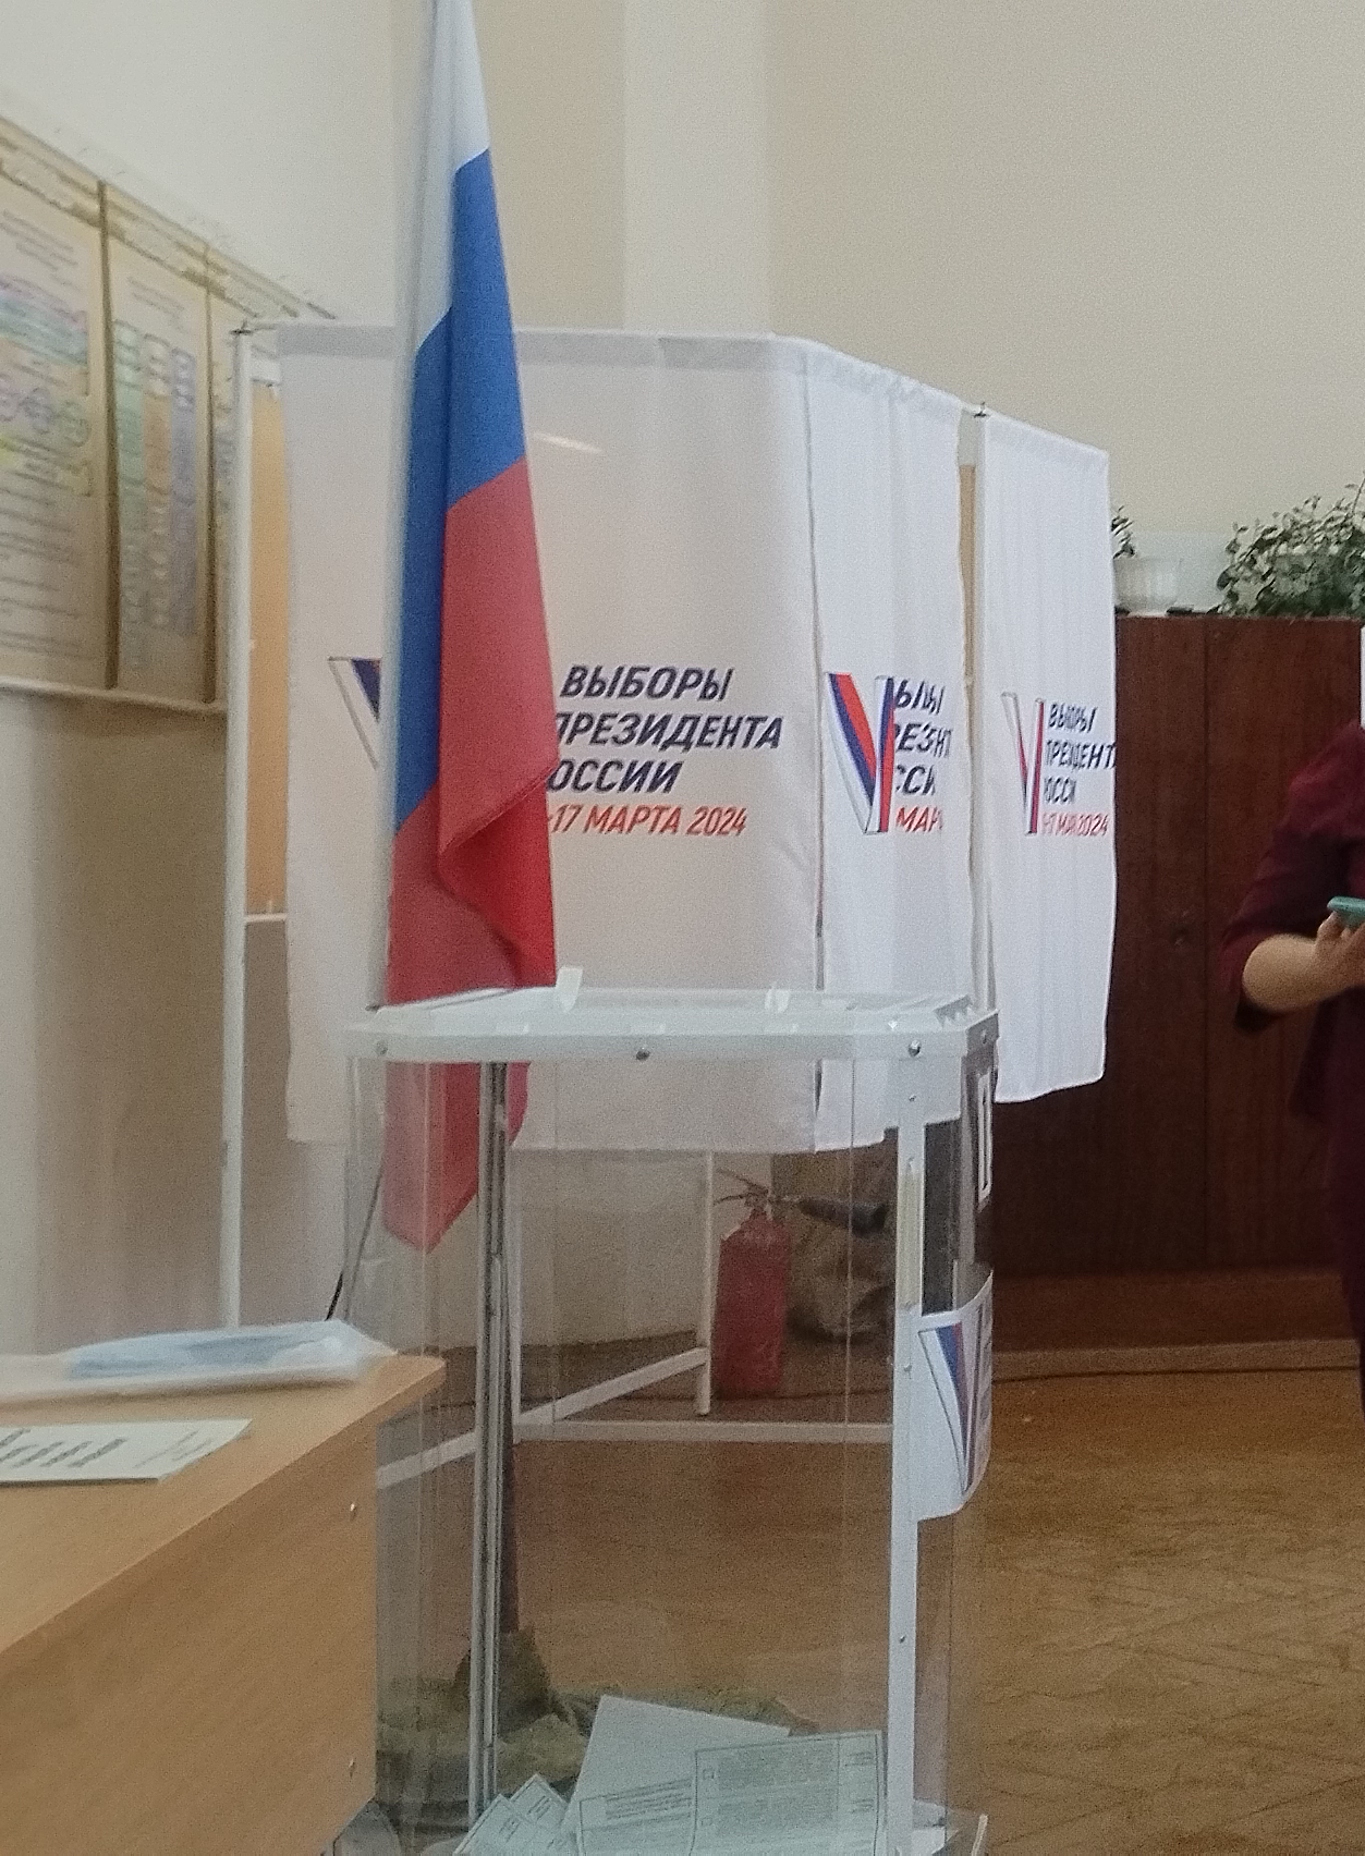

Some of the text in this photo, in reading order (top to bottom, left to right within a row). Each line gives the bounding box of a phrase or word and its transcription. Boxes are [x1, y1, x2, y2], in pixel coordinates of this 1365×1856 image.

[559, 665, 735, 701] ВЫБОРЫ
[546, 758, 685, 794] ОССИИ
[584, 803, 683, 835] МАРТА
[686, 805, 748, 837] 2024
